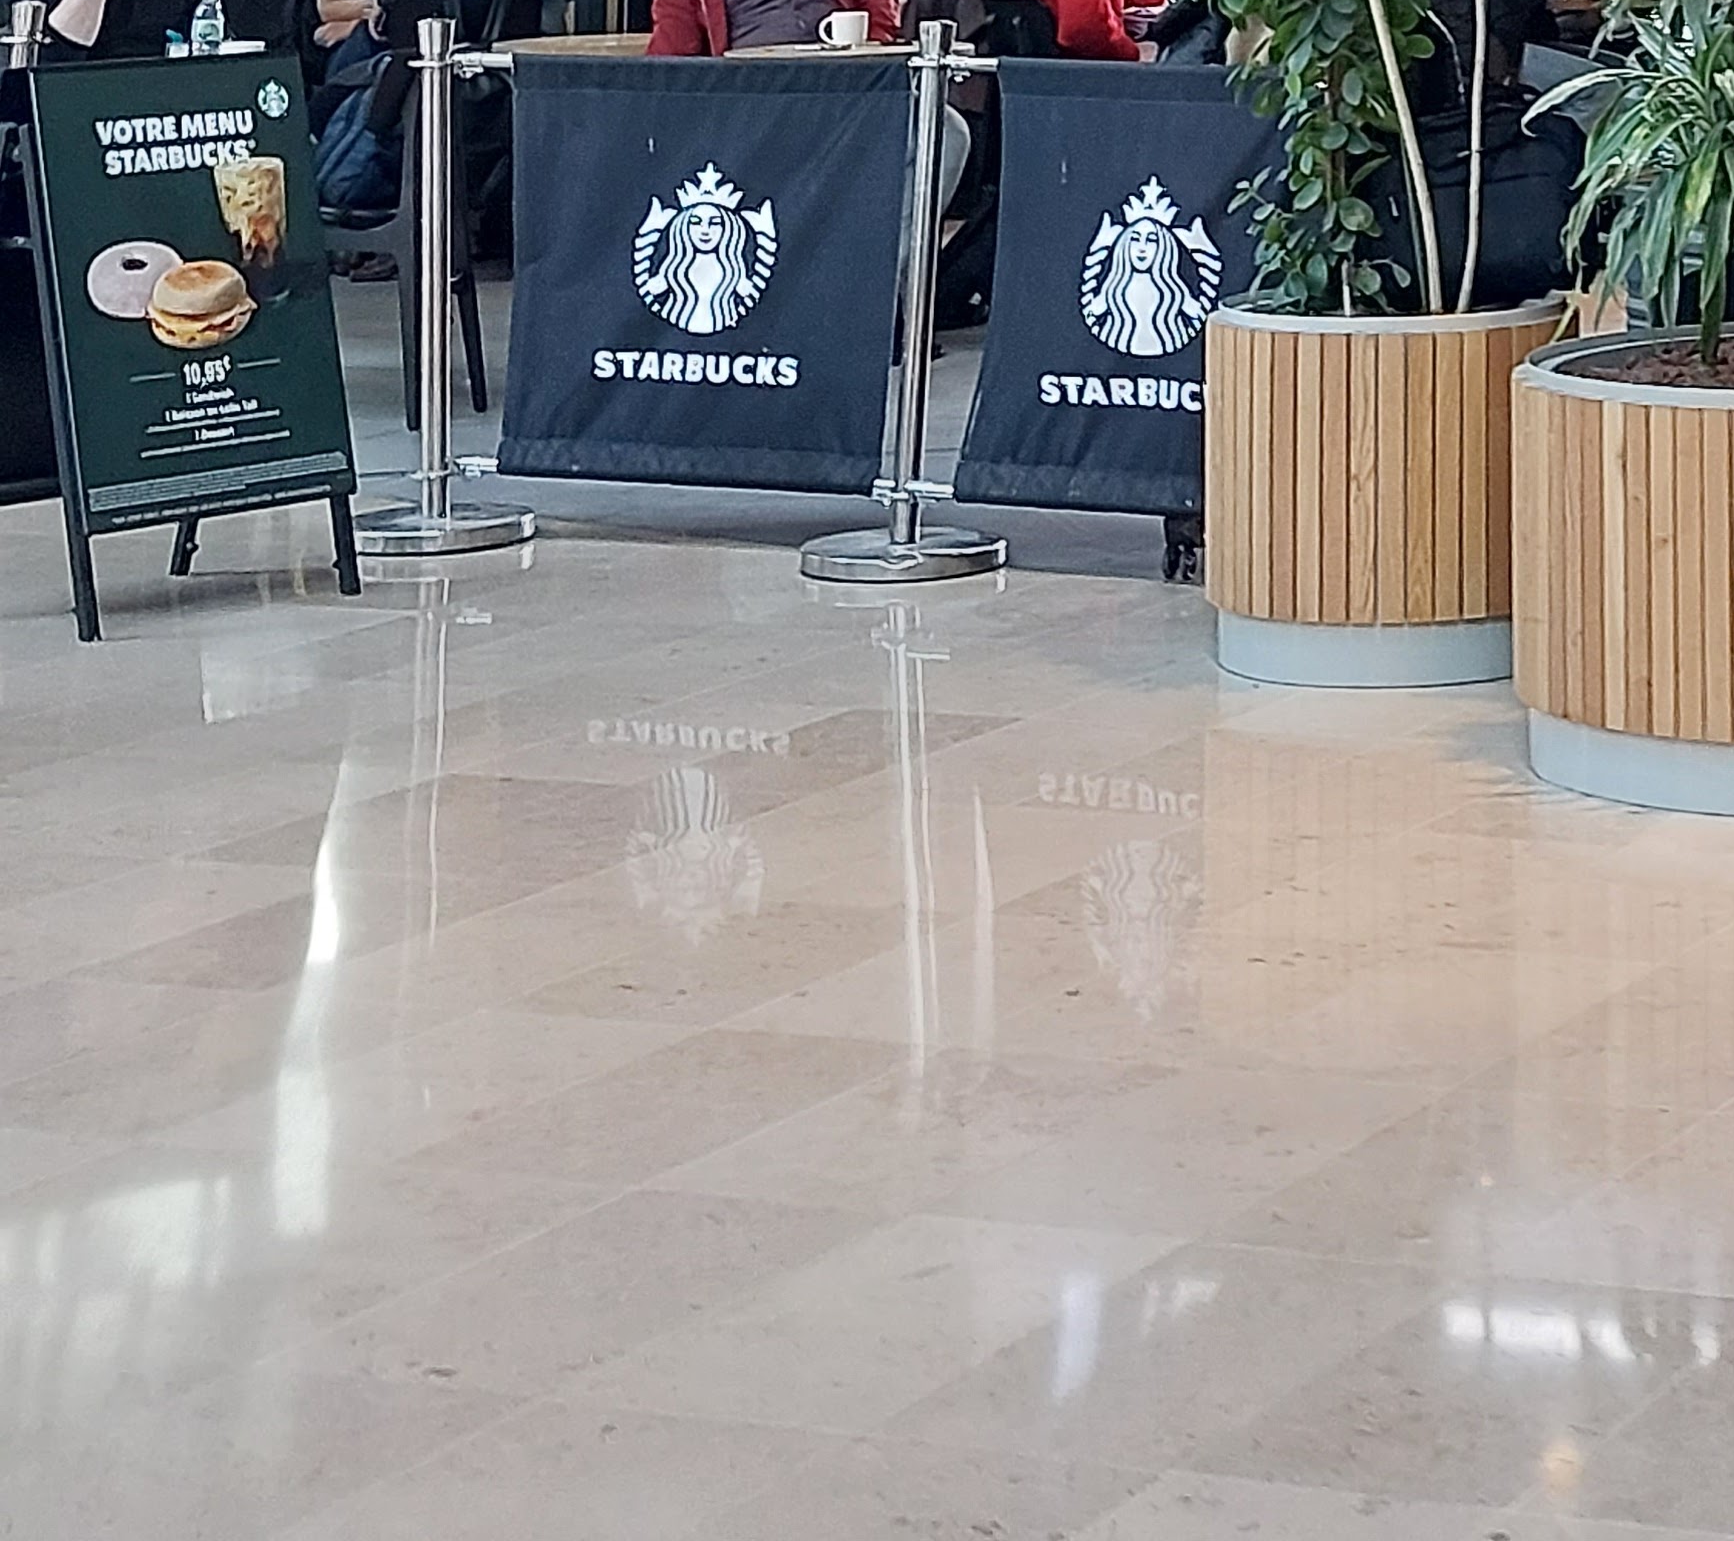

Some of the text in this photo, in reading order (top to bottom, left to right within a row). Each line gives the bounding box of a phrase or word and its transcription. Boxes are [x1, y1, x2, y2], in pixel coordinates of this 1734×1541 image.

[95, 110, 254, 146] VOTRE MENU
[593, 349, 800, 387] STARBUCKS
[1039, 374, 1203, 412] STARBUC
